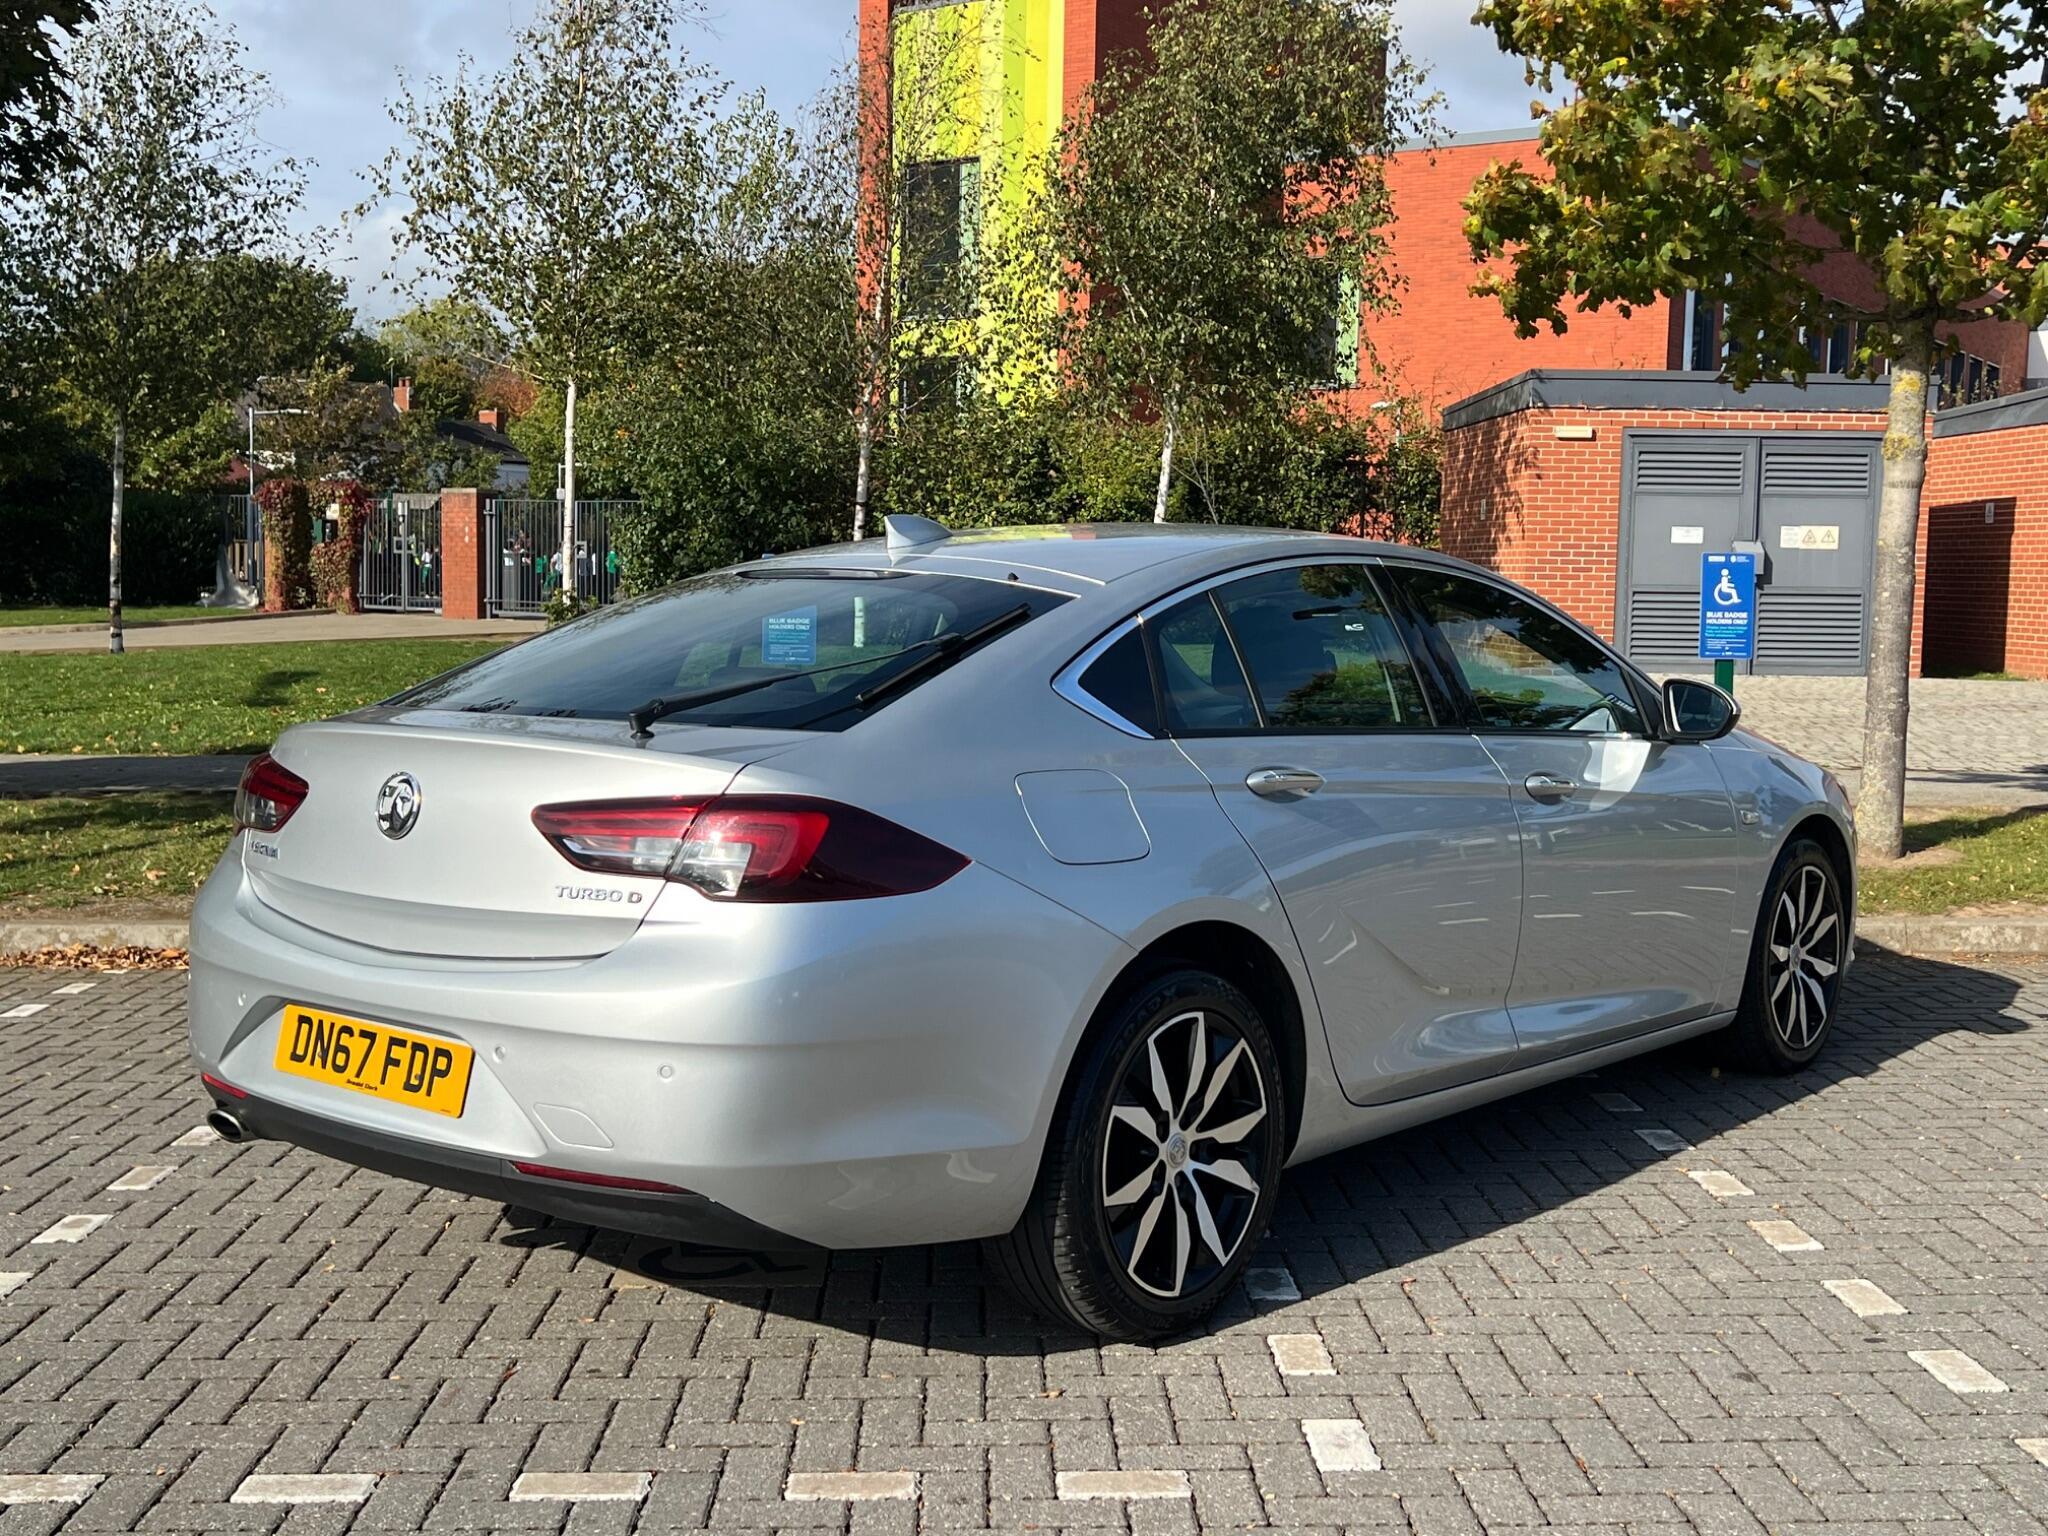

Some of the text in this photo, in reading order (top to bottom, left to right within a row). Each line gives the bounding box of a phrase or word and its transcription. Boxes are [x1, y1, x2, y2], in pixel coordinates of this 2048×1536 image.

[768, 617, 811, 625] BLUE BADGE
[555, 885, 643, 904] TURBO D
[289, 1014, 453, 1097] DN67 FDP
